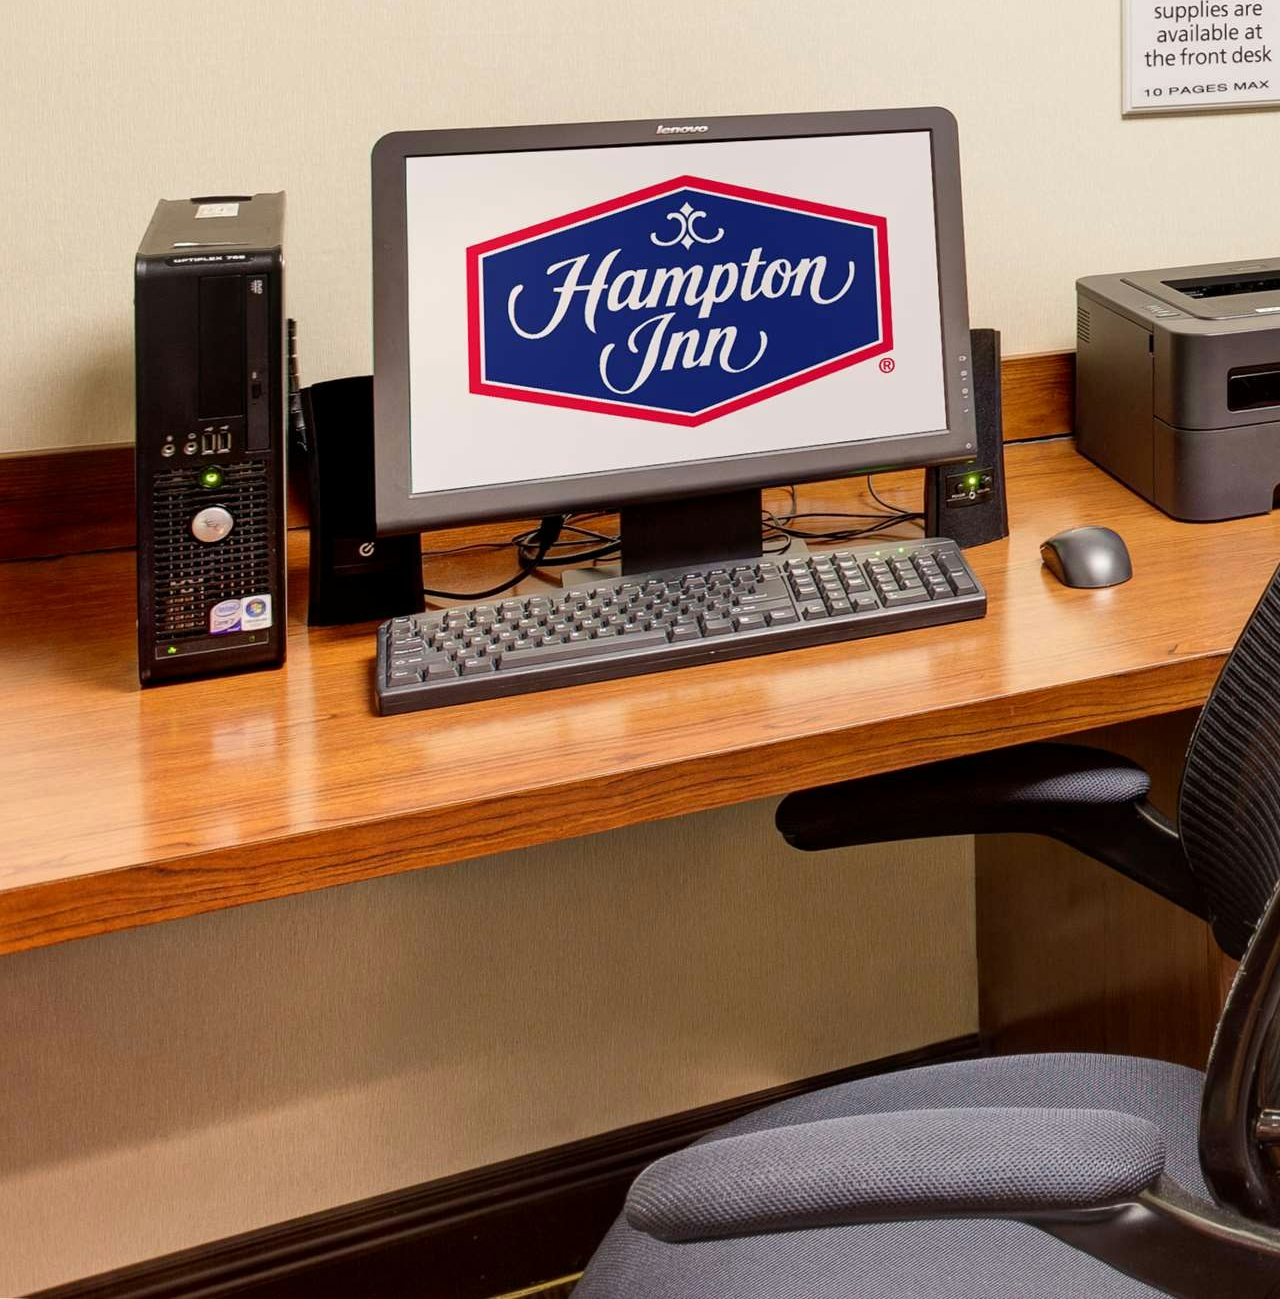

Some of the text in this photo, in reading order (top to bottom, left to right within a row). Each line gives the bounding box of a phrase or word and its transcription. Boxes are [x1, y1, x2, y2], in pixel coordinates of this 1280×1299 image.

[1154, 0, 1263, 23] supplies are
[1156, 22, 1263, 43] available at
[1144, 45, 1272, 68] the front desk
[1144, 80, 1270, 98] 10 PAGES MAX
[656, 125, 709, 135] lenovo
[507, 247, 855, 340] Hampton
[599, 312, 768, 395] Inn
